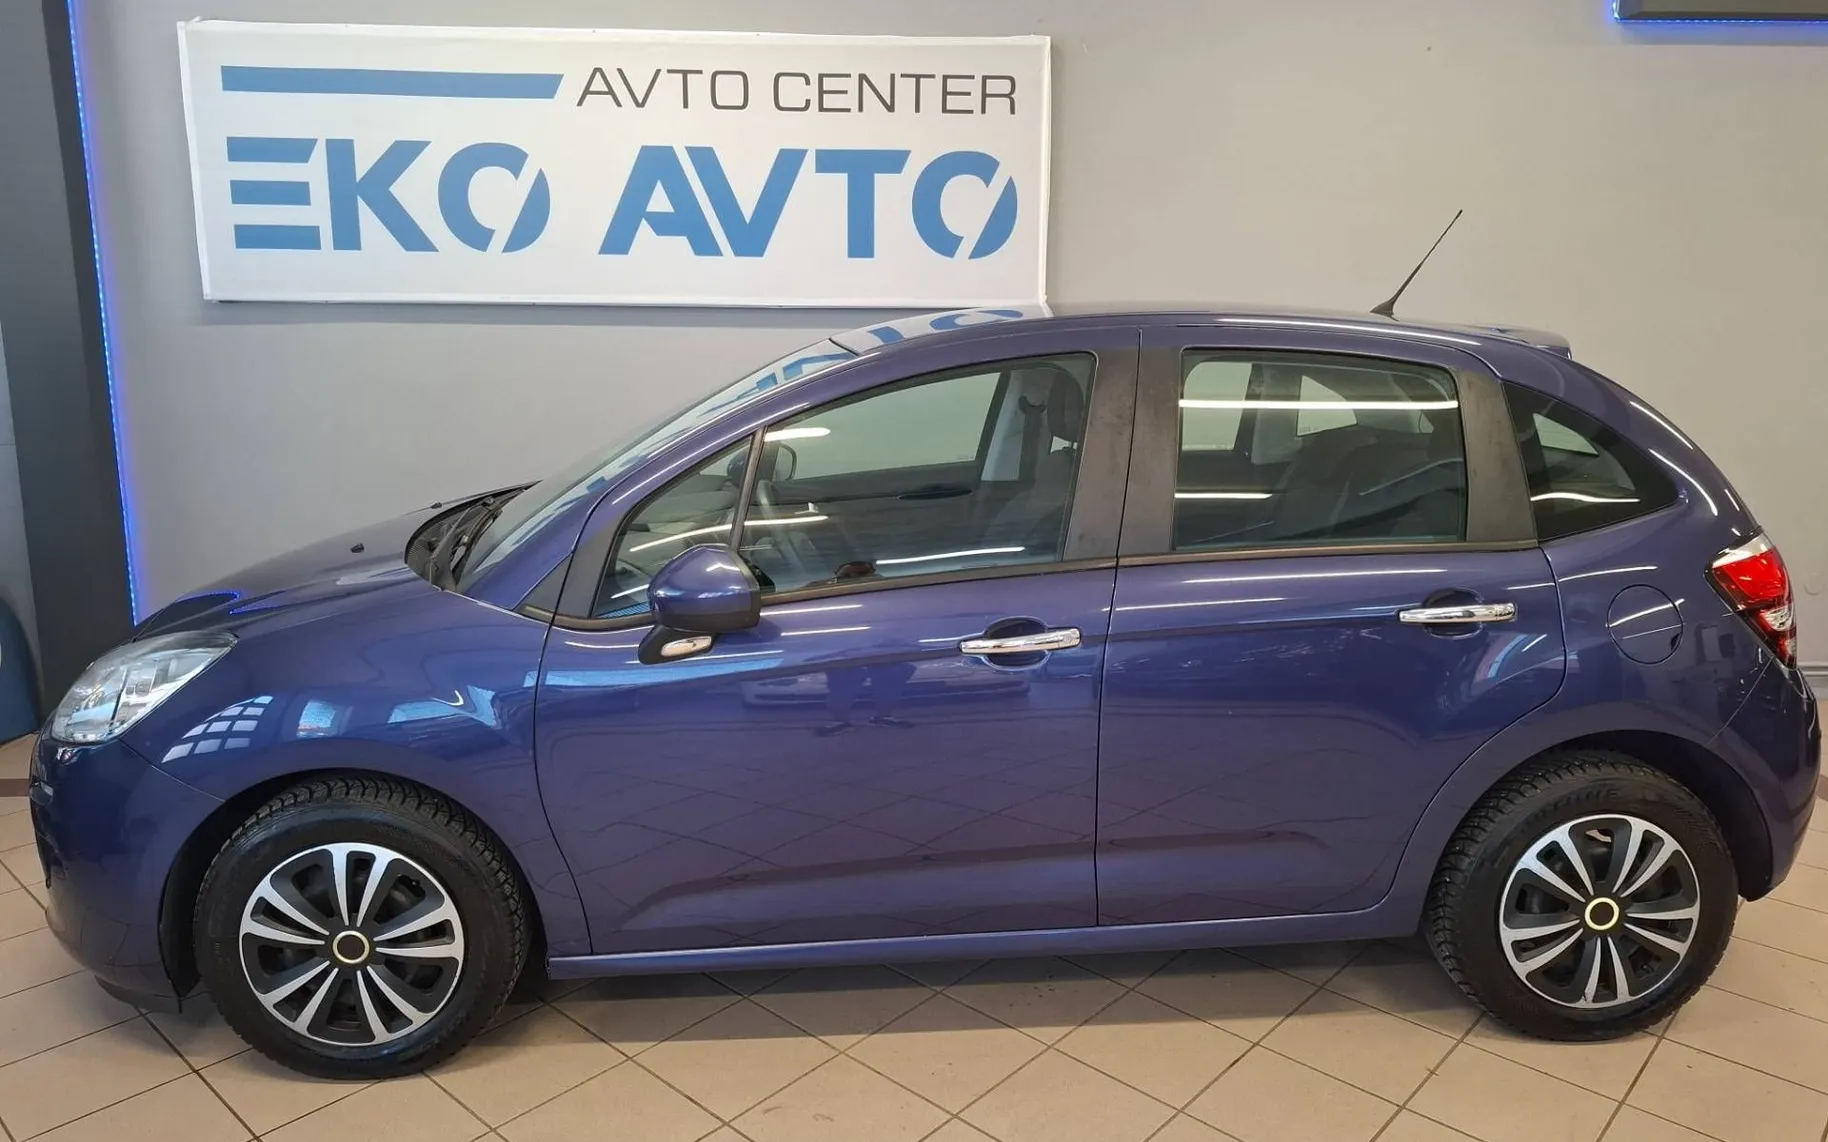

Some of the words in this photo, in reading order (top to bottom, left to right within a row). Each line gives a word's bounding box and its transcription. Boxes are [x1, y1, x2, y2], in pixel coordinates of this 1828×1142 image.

[576, 67, 749, 111] AVTO
[772, 72, 1017, 115] CENTER
[226, 136, 551, 254] EKO
[599, 146, 1019, 260] AVTO
